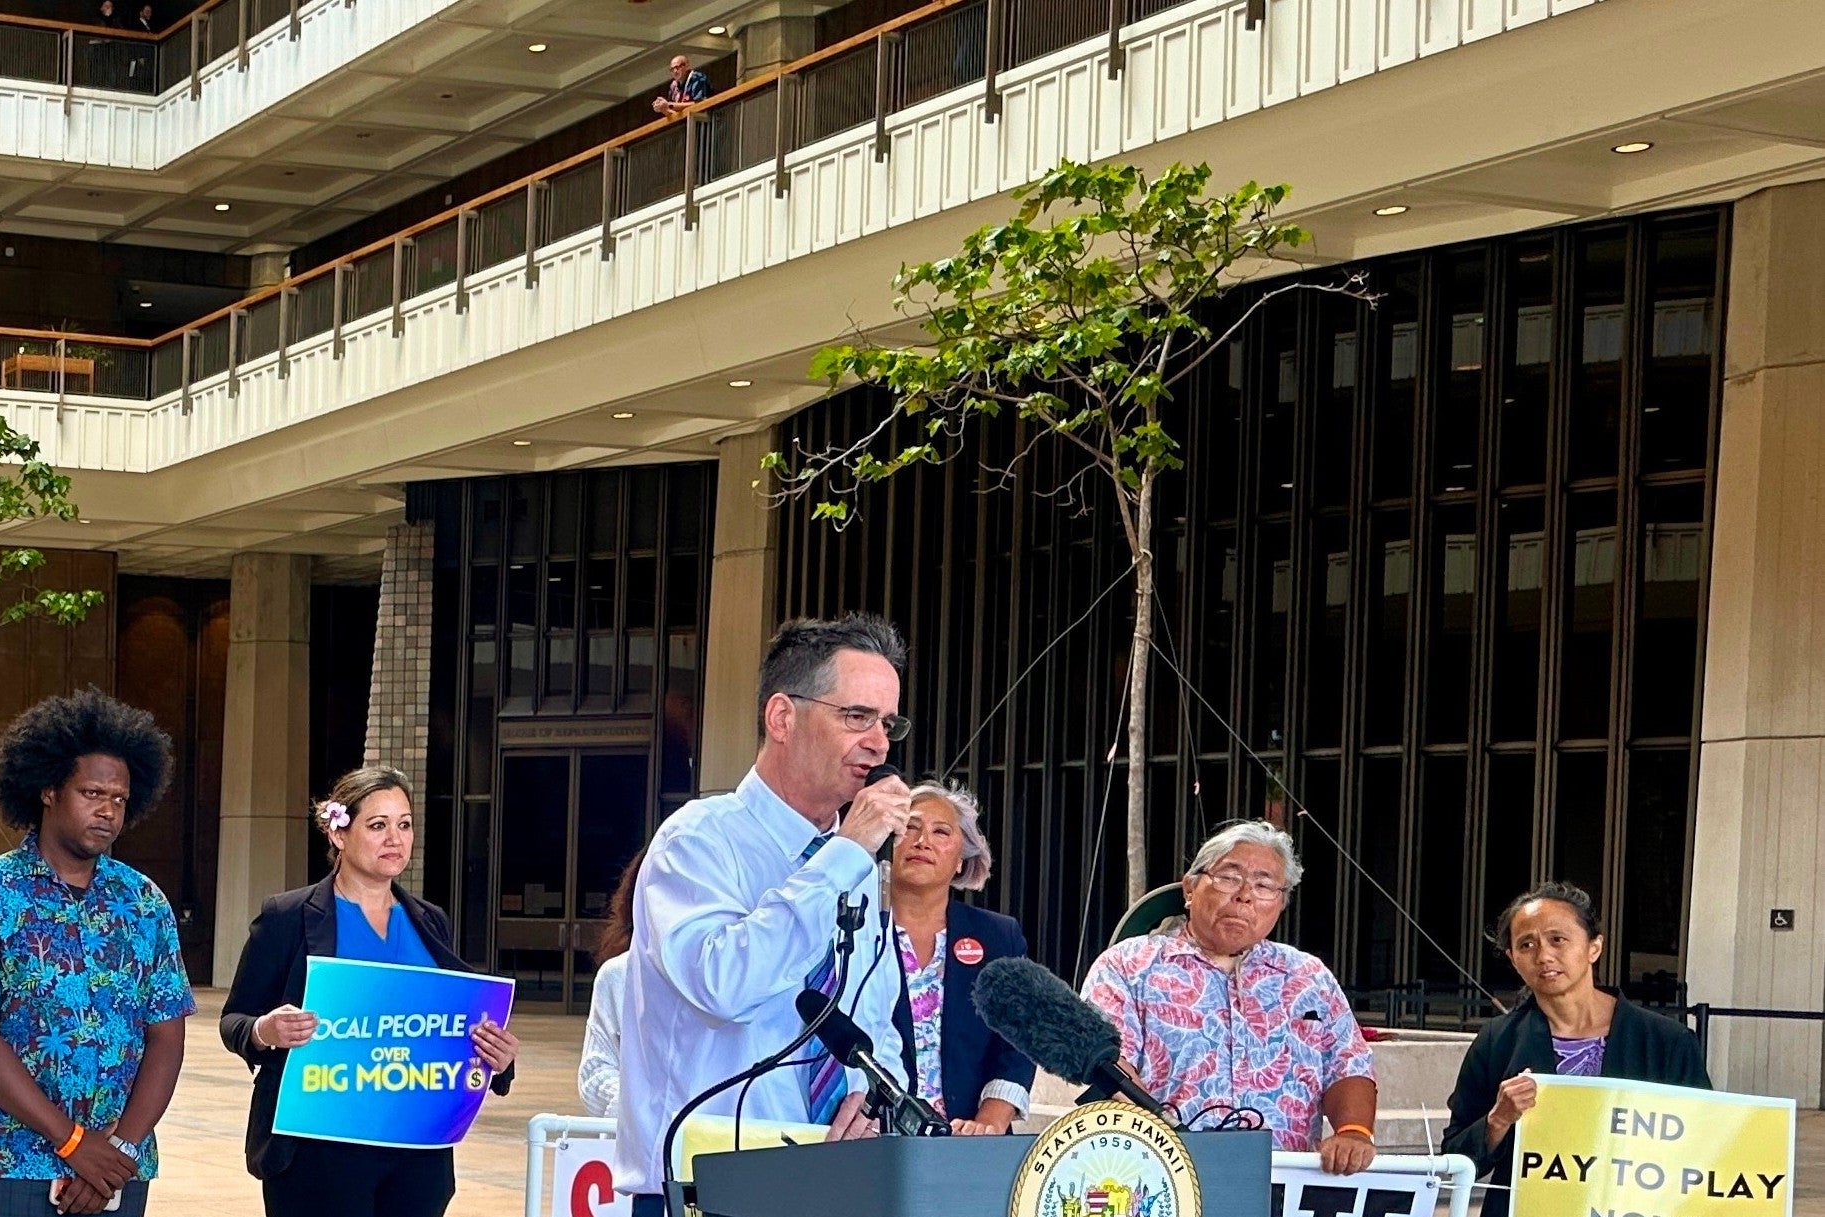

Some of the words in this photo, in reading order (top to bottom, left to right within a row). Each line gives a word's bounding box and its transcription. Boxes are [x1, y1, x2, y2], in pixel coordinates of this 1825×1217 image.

[312, 1016, 373, 1041] OCAL
[377, 1013, 468, 1039] PEOPLE
[371, 1047, 411, 1062] OVER
[302, 1064, 349, 1092] BIG
[356, 1061, 463, 1092] MONEY
[1610, 1107, 1685, 1141] END
[1034, 1119, 1087, 1174] STATE
[1096, 1113, 1124, 1126] OF
[1131, 1117, 1184, 1174] HAWAII
[1090, 1136, 1132, 1151] 1959
[1521, 1152, 1598, 1182] PAY
[1611, 1158, 1665, 1190] TO
[1681, 1167, 1785, 1200] PLAY
